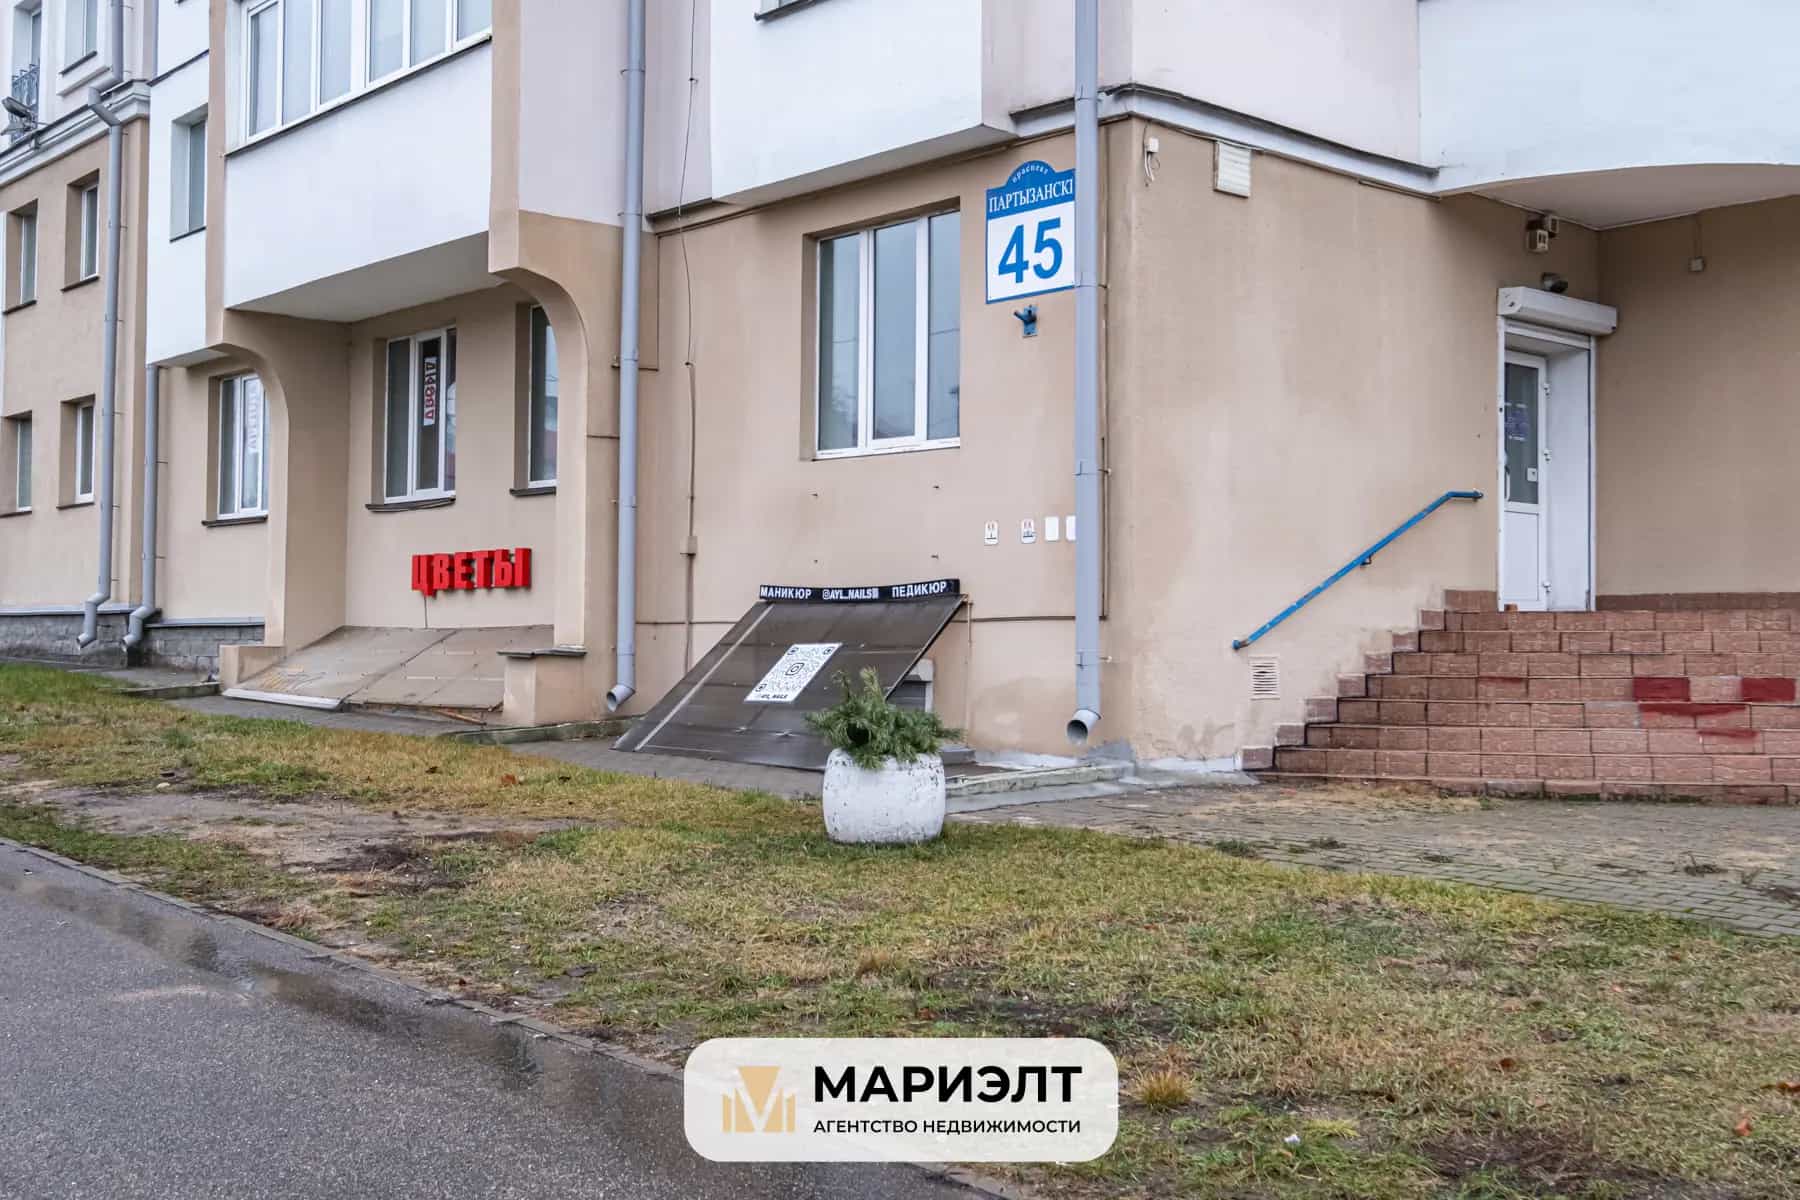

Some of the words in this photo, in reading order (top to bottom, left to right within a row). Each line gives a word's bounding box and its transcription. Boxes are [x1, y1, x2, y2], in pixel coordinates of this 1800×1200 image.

[998, 217, 1063, 284] 45
[411, 548, 532, 598] ЦВЕТЫ
[760, 586, 812, 600] МАНИКЮР
[891, 580, 947, 598] ПЕДИКЮР
